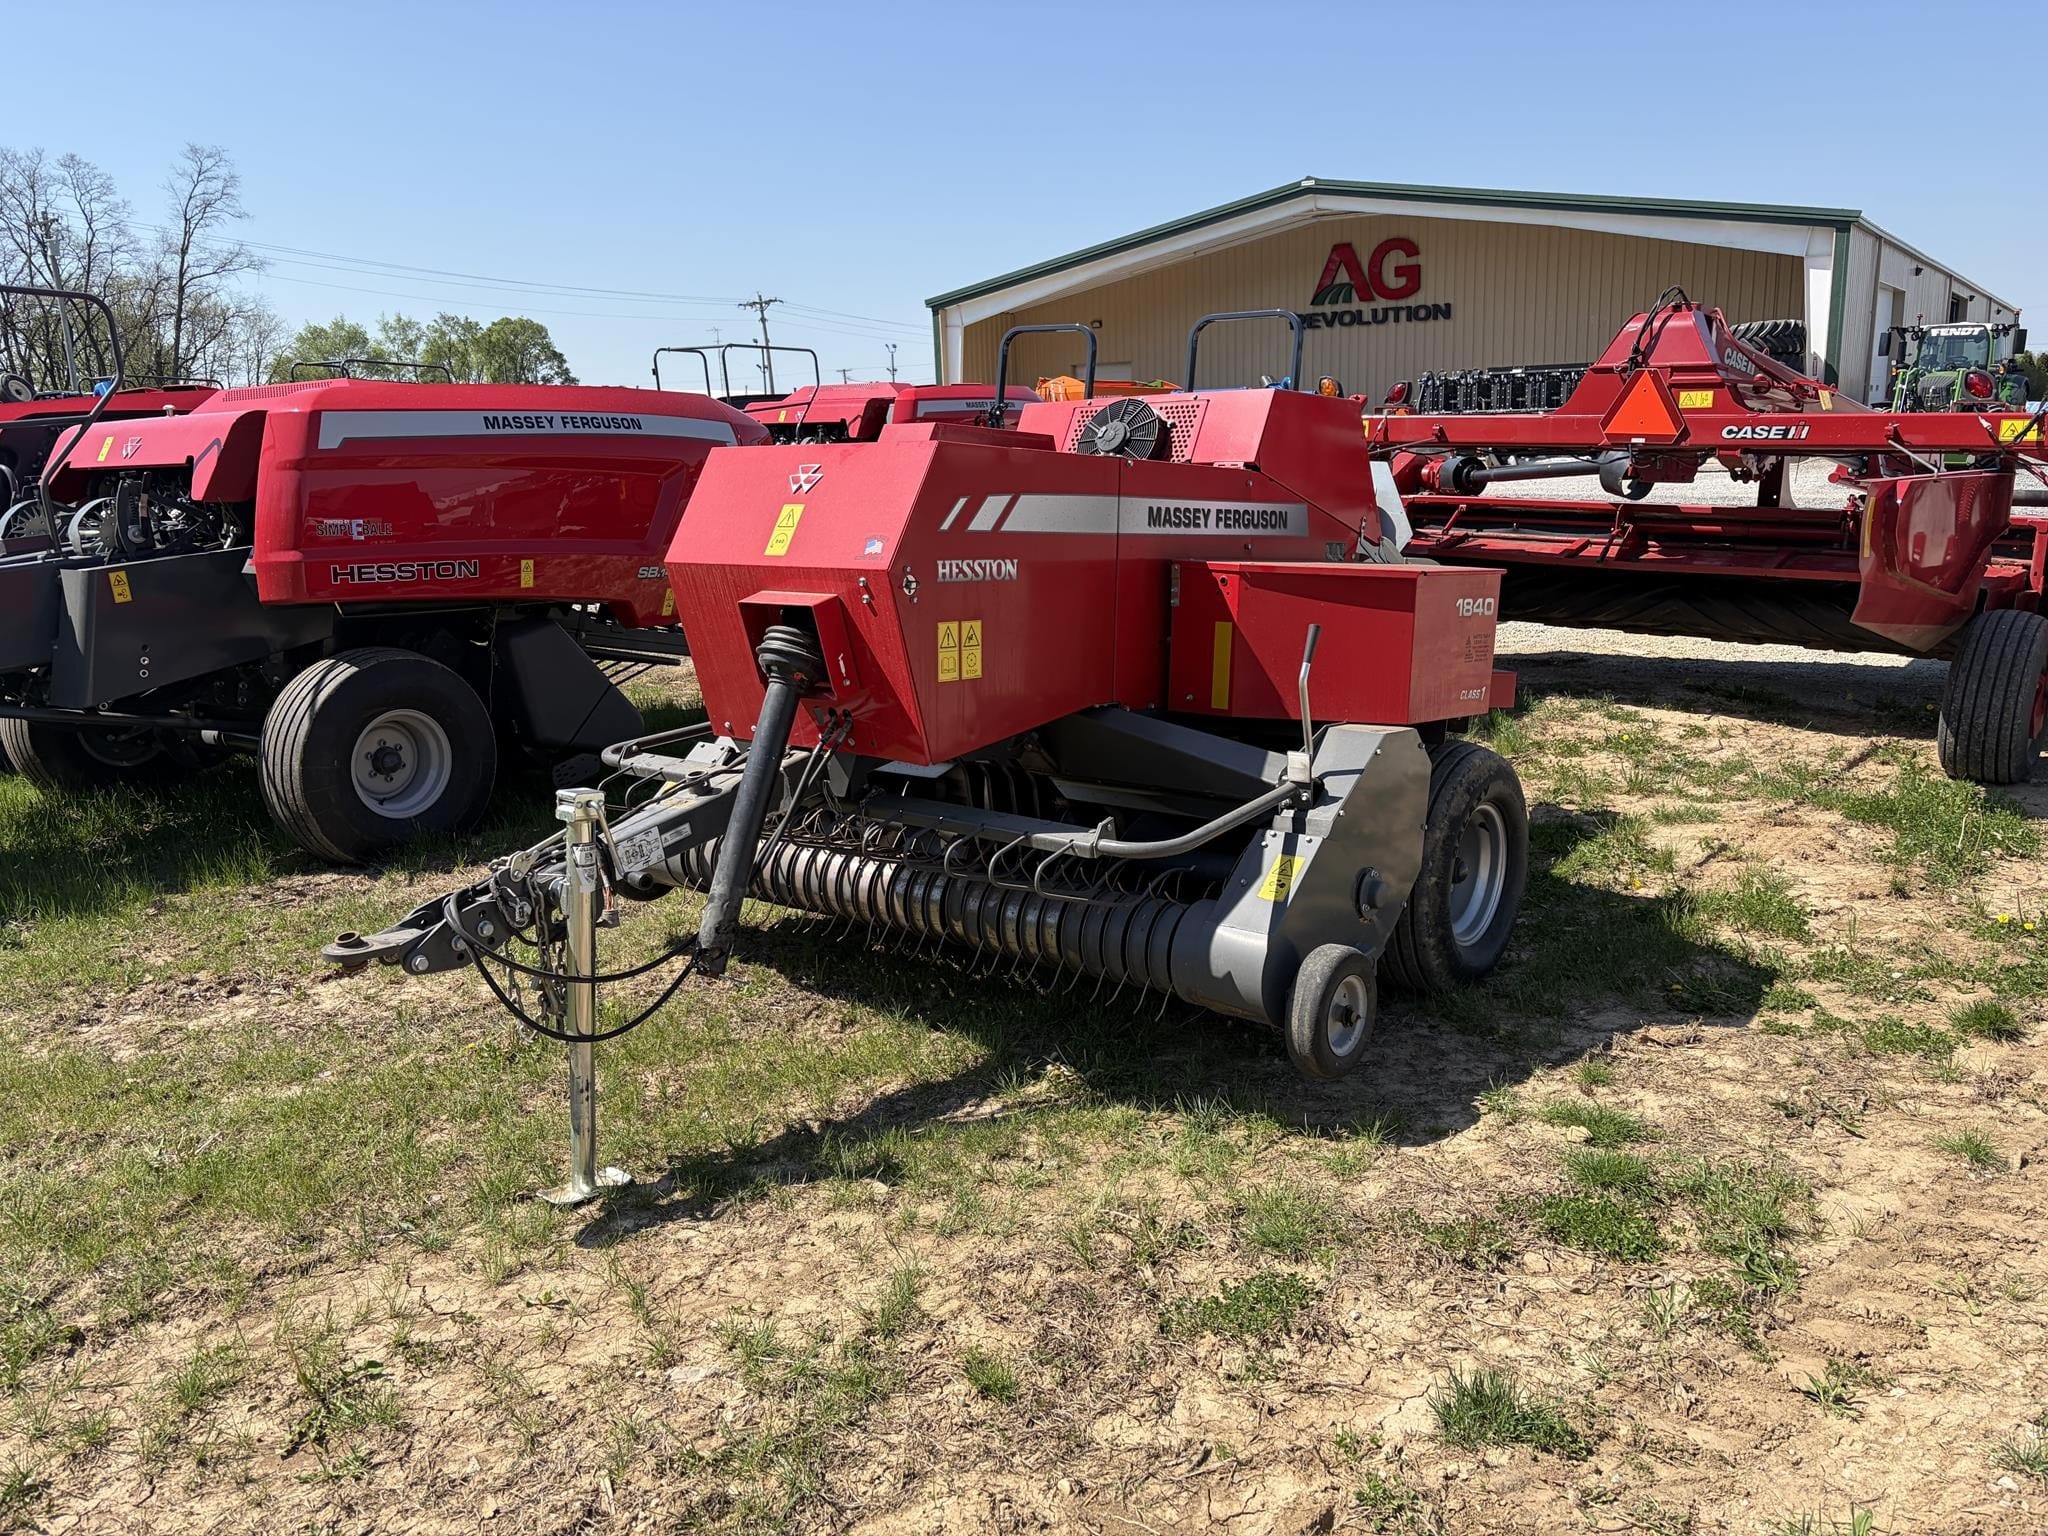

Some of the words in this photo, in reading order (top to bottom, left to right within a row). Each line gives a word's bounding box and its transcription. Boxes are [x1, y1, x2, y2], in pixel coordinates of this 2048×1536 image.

[1311, 237, 1421, 305] AG
[1931, 327, 1985, 336] FENDT
[1724, 347, 1748, 371] CASE
[483, 416, 555, 430] MASSEY
[560, 416, 643, 430] FERGUSON
[1721, 425, 1786, 439] CASE
[1147, 506, 1211, 529] MASSEY
[1215, 508, 1288, 530] FERGUSON
[331, 559, 479, 585] HESSTON
[637, 566, 668, 578] SB.1
[936, 559, 1018, 583] HESSTON
[1456, 598, 1494, 617] 1840
[1460, 689, 1481, 700] CLASS
